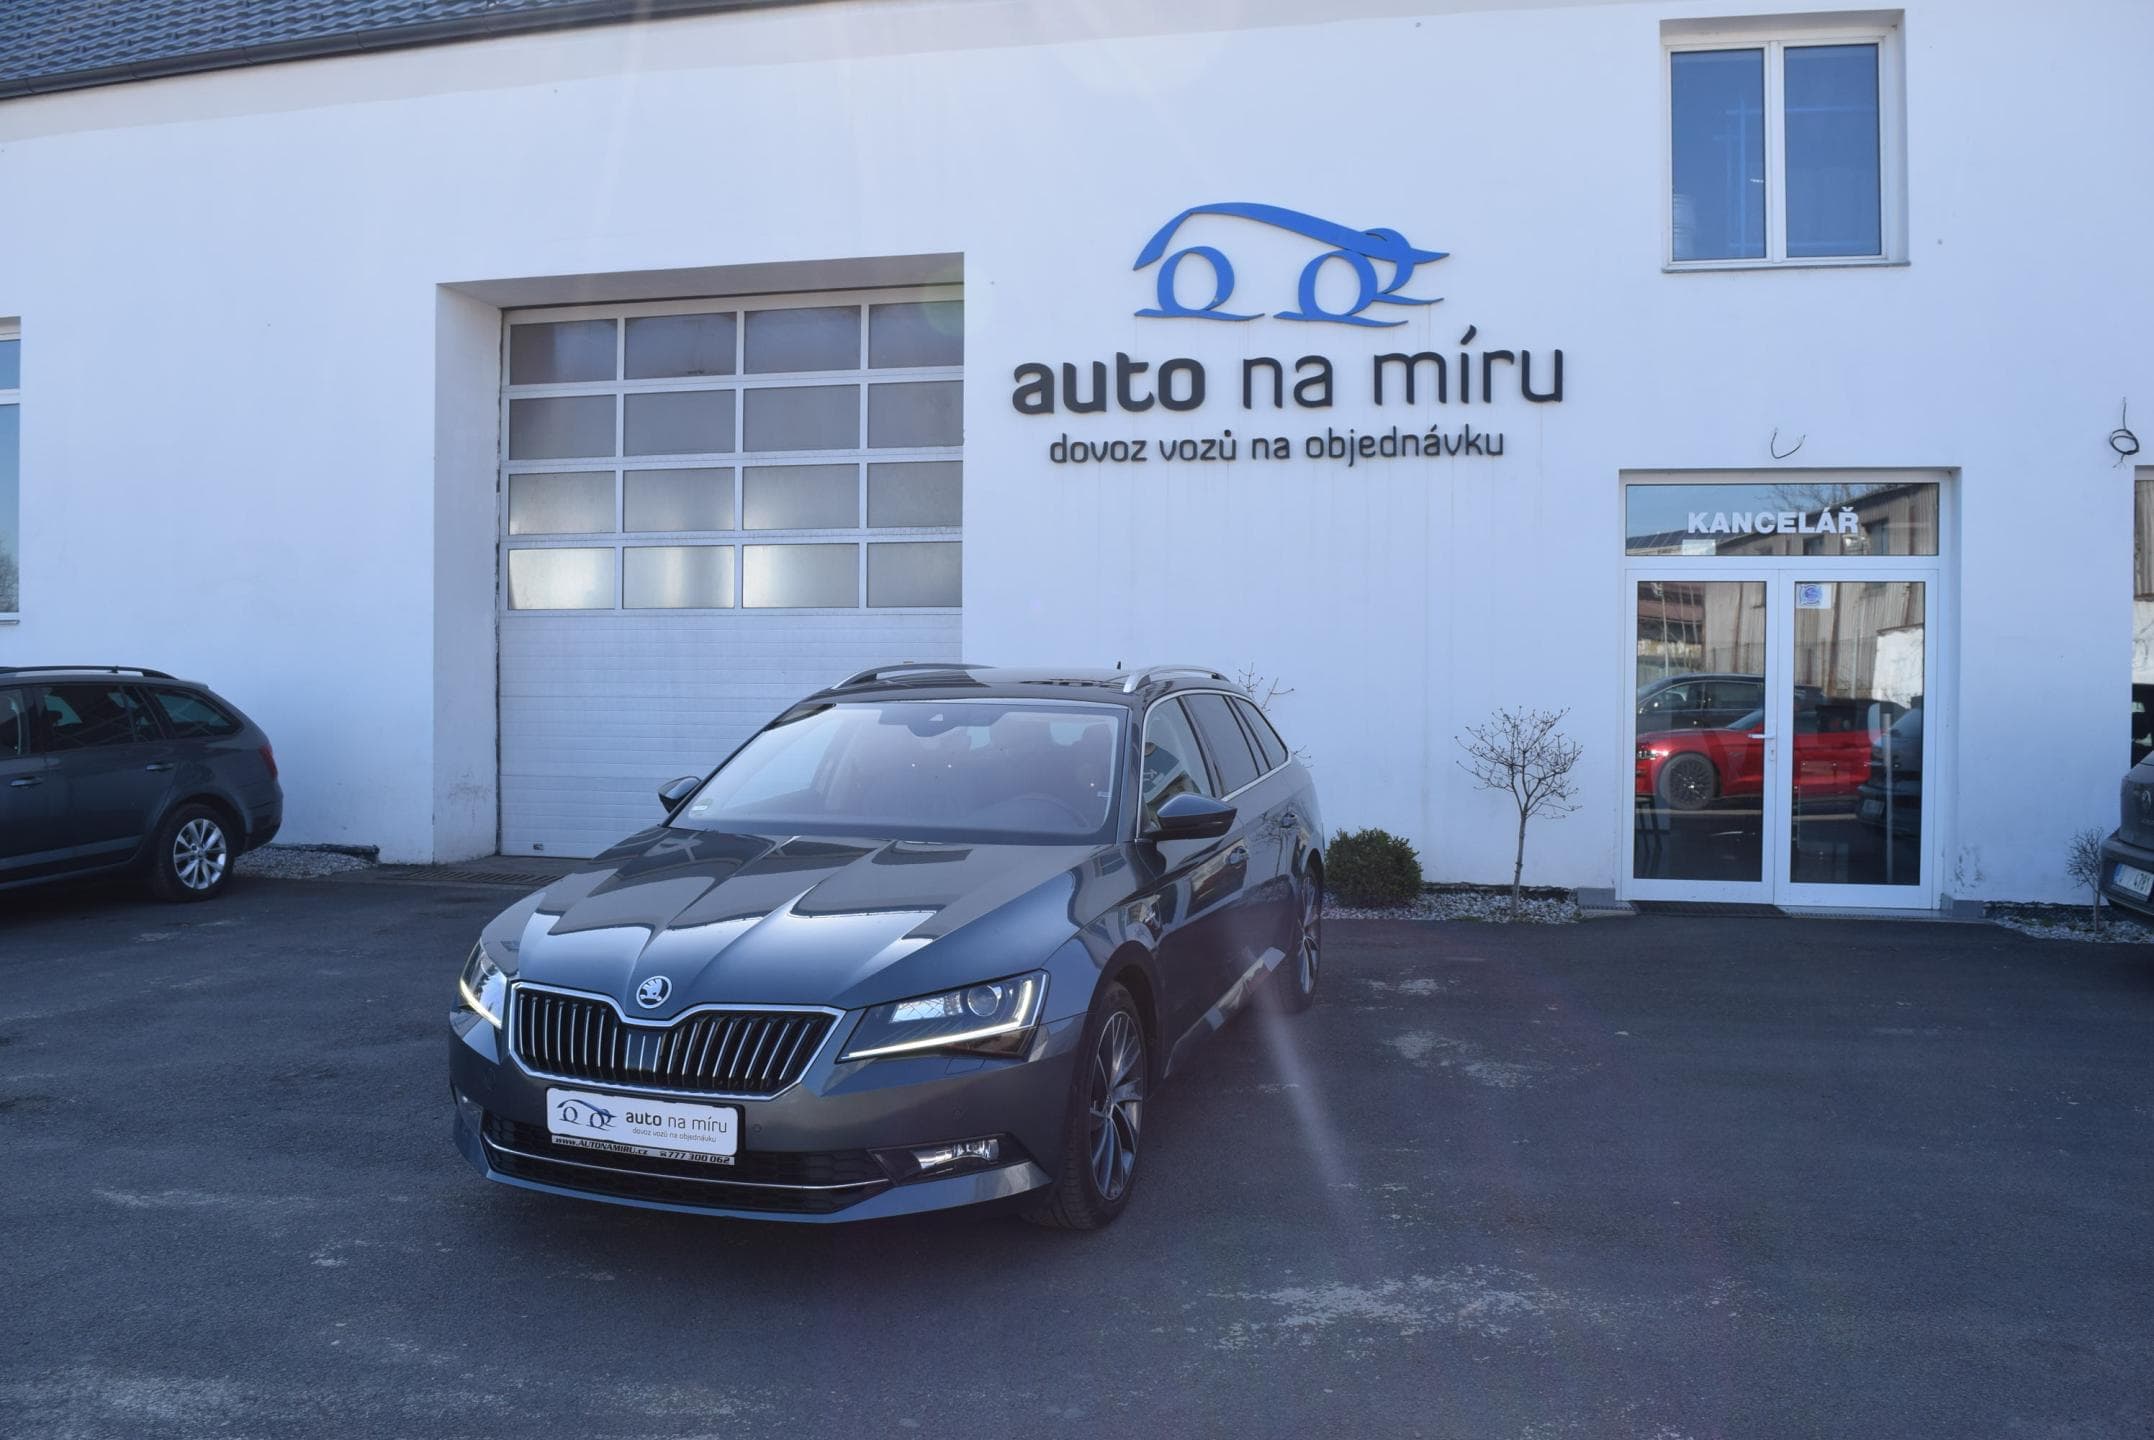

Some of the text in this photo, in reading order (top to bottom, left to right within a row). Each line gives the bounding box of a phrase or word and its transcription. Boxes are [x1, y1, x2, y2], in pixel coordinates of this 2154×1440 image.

[1012, 325, 1563, 415] auto na míru
[1050, 424, 1504, 468] dovoz vozů na objednávku
[1687, 506, 1859, 534] KANCELÁŘ
[625, 1111, 728, 1133] auto na míru
[632, 1127, 652, 1136] dovoz
[669, 1131, 678, 1139] na
